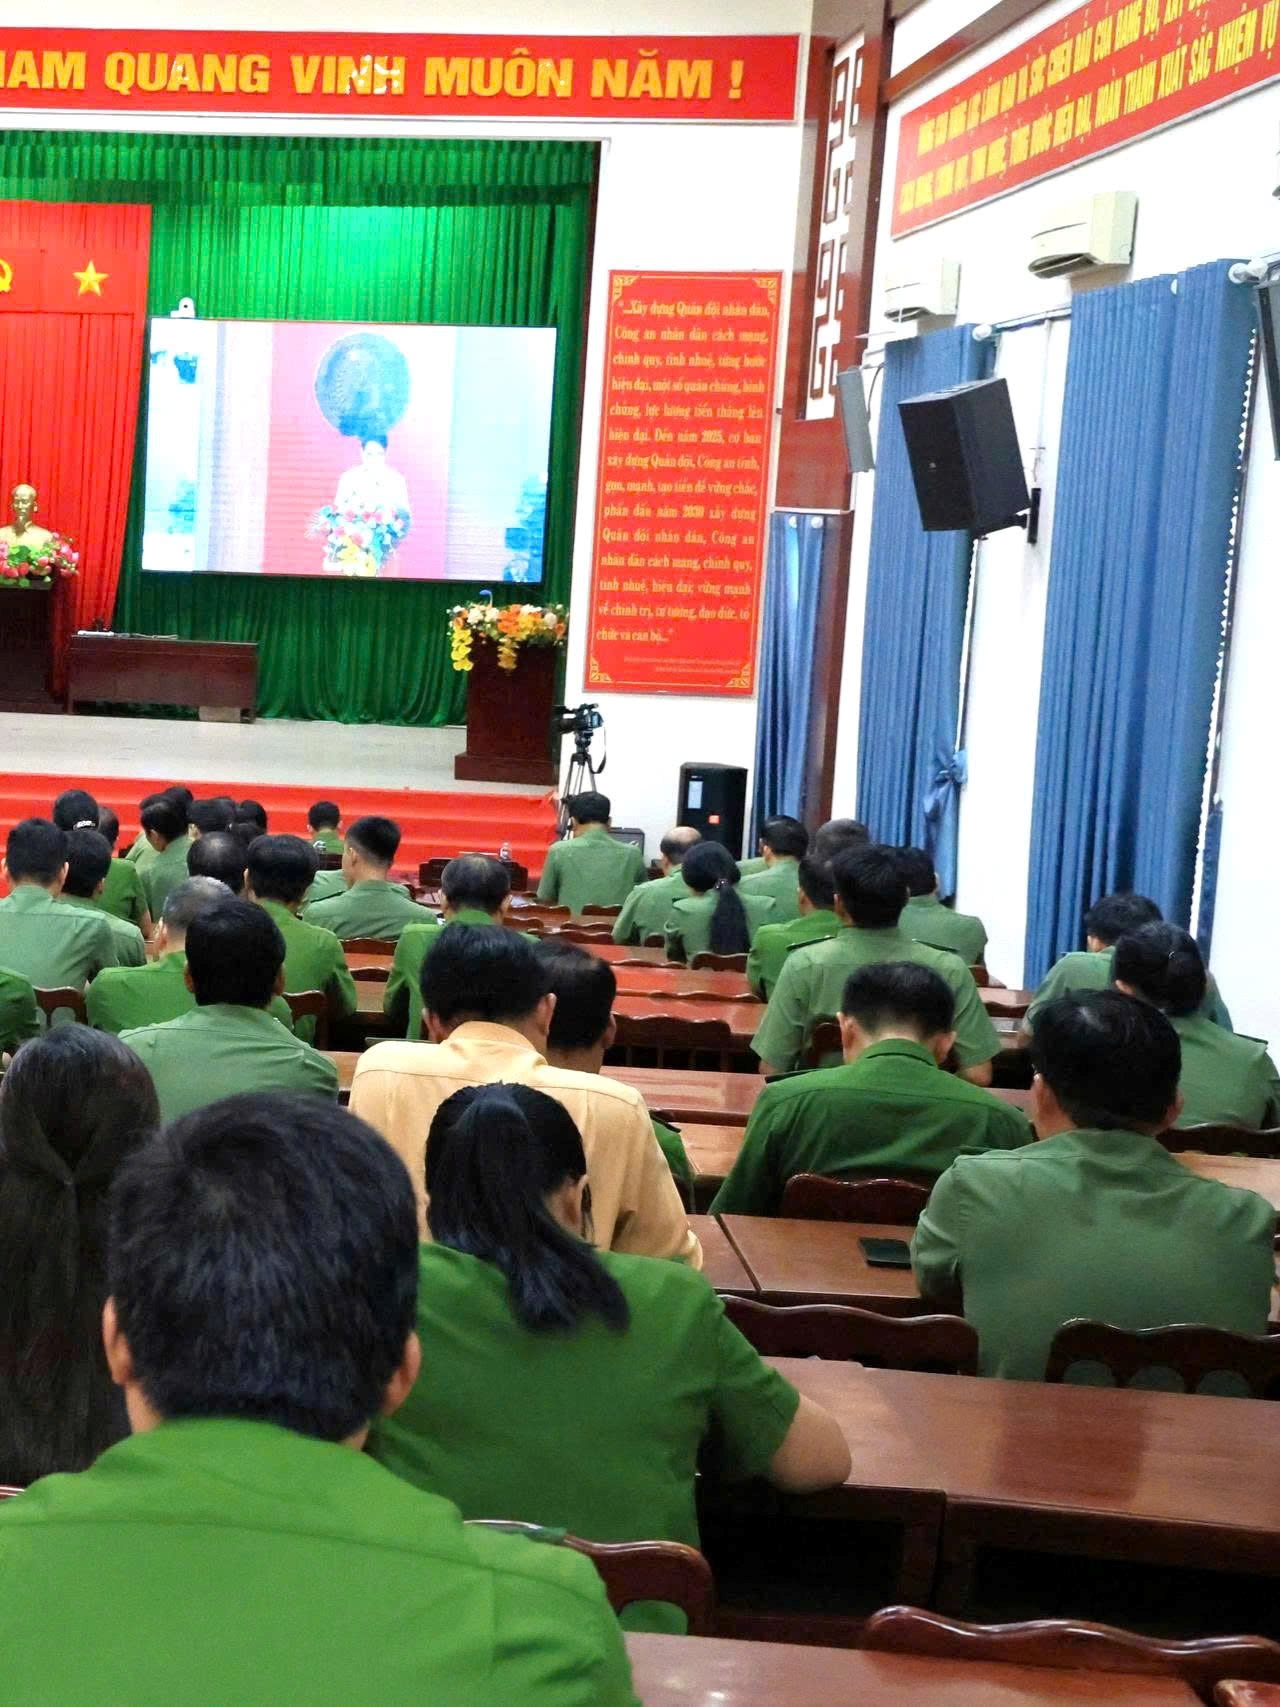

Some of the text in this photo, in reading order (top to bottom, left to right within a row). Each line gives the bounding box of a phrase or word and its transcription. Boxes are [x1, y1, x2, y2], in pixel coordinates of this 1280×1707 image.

[104, 51, 271, 95] QUANG
[290, 54, 406, 96] VINH
[423, 47, 574, 98] MUÔN
[590, 48, 713, 99] NĂM
[728, 59, 744, 99] !
